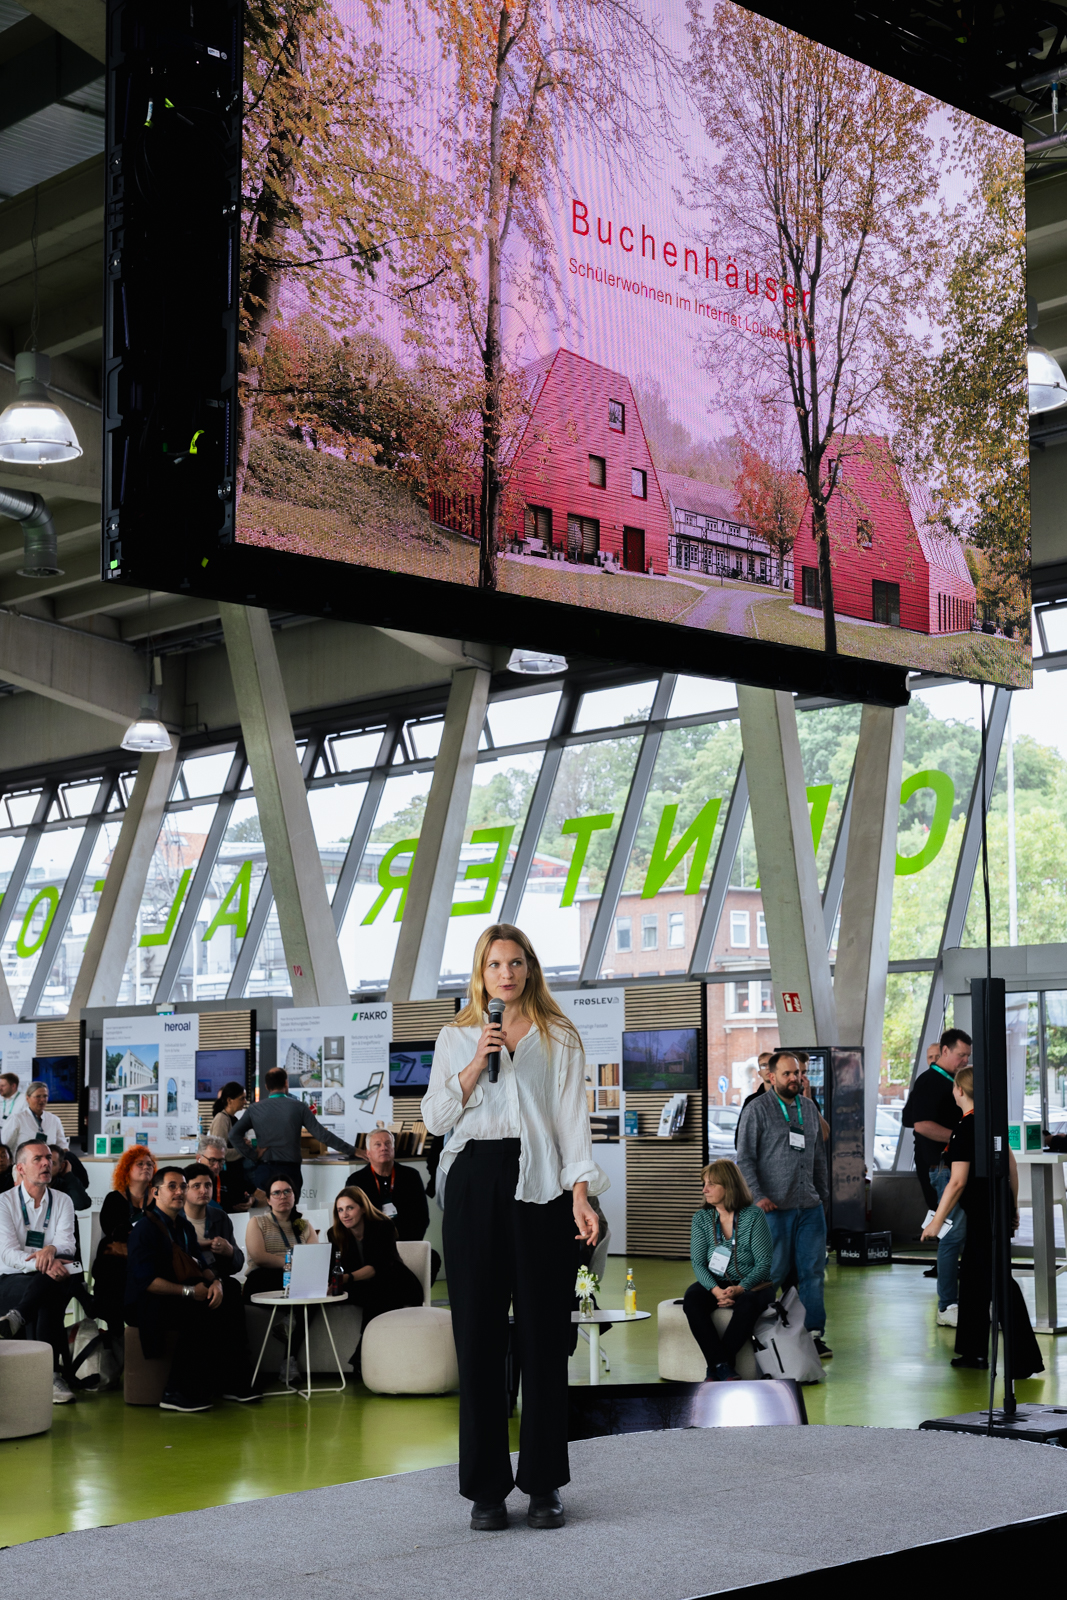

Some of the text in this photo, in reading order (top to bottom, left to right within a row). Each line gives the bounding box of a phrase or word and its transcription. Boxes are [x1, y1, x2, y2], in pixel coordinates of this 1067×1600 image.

[572, 198, 811, 313] Buchenhäuser
[569, 257, 672, 306] Schülerwohnen
[676, 292, 691, 312] im
[694, 298, 742, 329] Internat
[573, 996, 613, 1006] FRØSLEV
[359, 1010, 388, 1021] FAKRO
[164, 1021, 191, 1032] heroal
[301, 1188, 318, 1199] SLEV
